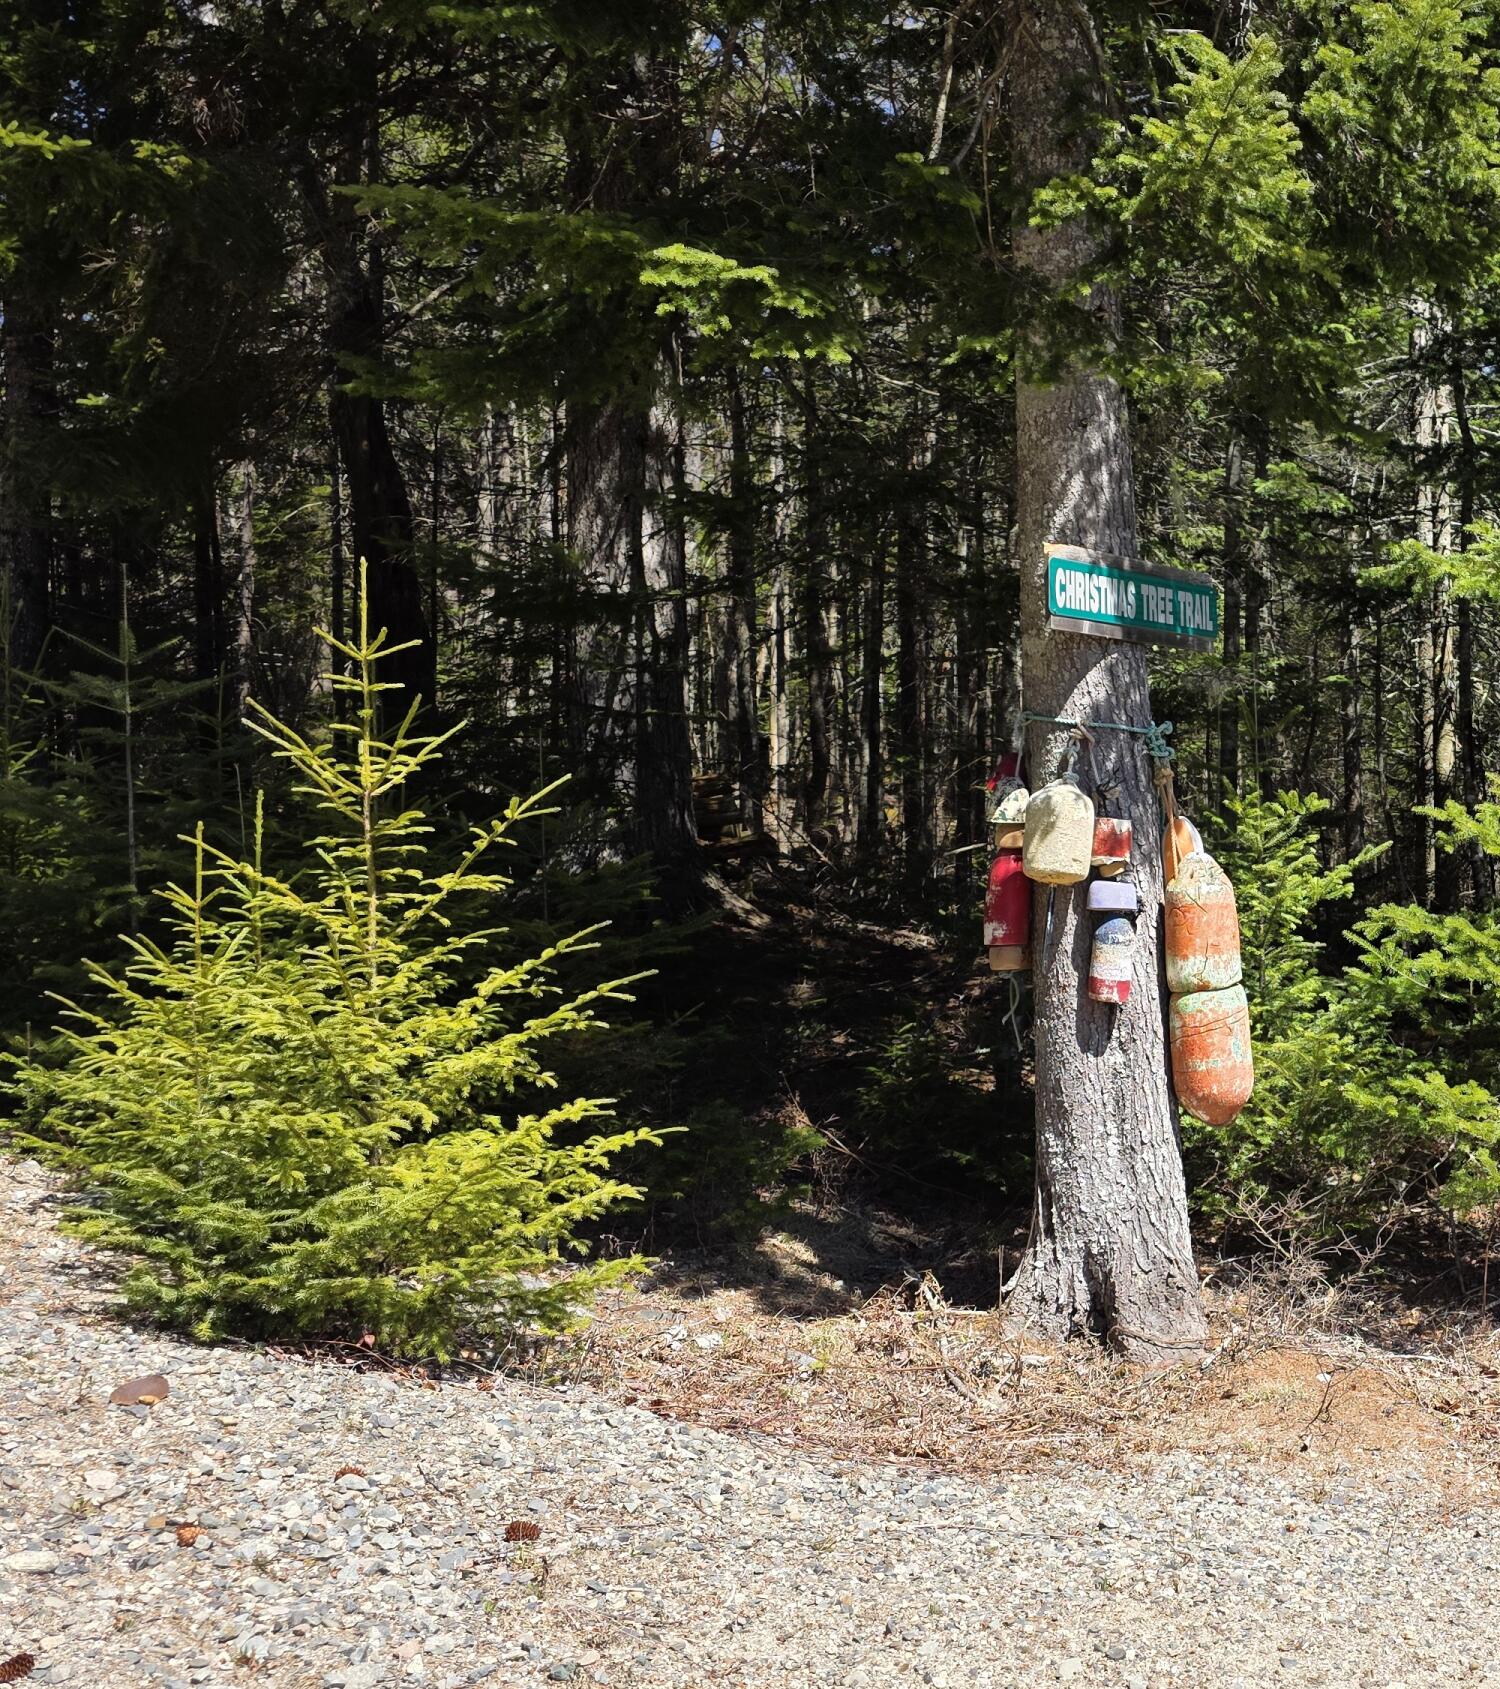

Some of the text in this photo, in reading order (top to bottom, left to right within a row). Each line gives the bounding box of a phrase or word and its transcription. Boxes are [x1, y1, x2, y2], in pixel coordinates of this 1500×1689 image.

[1055, 567, 1213, 631] CHRISTMAS TREE TRAIL
